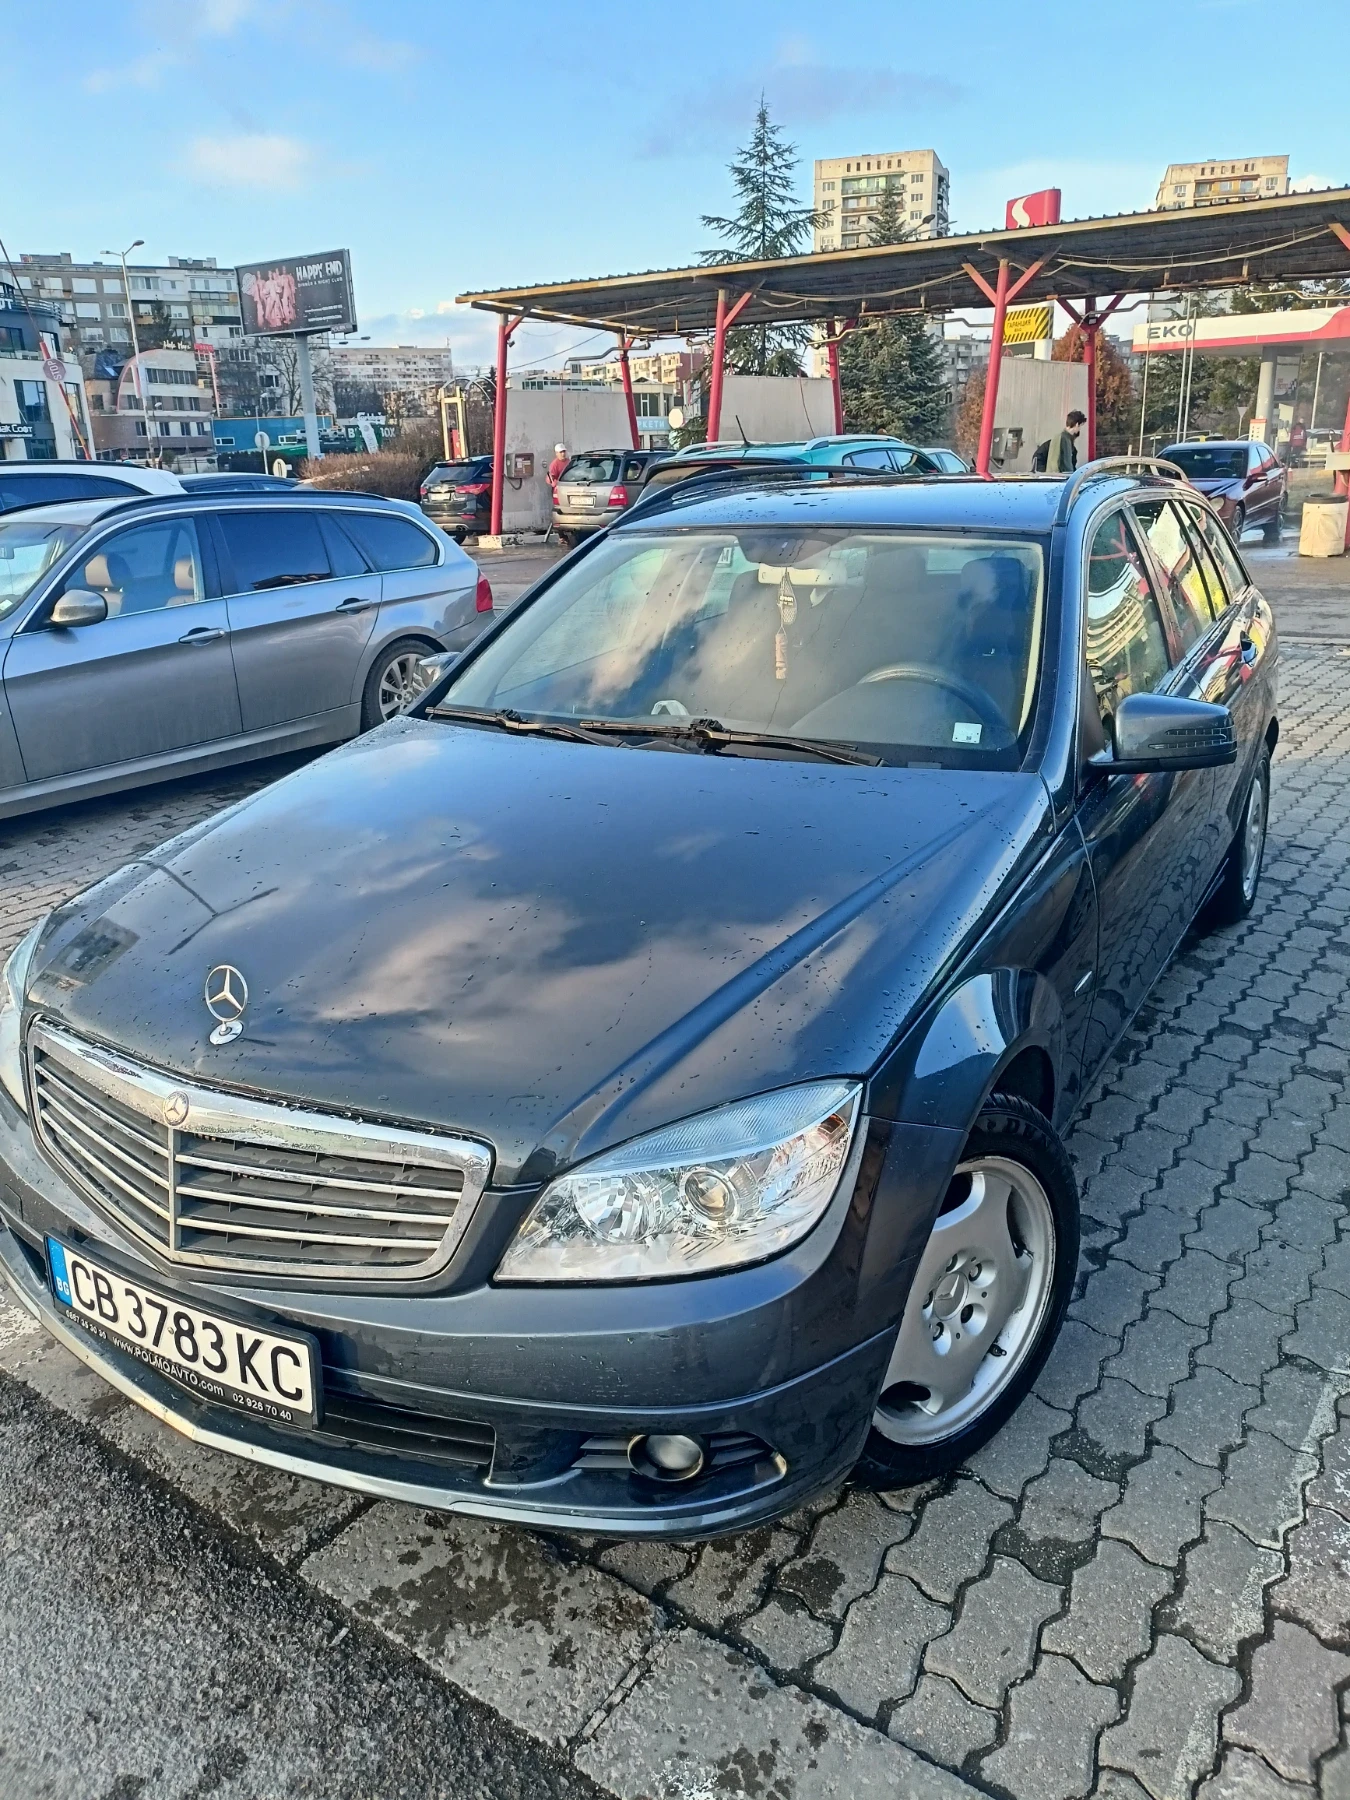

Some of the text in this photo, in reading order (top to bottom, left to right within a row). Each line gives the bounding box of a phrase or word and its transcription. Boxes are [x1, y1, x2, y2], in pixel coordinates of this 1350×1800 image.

[295, 260, 343, 281] HAPPY END
[1147, 324, 1193, 339] EKO
[47, 359, 63, 381] STOP
[55, 1275, 70, 1296] BG
[71, 1260, 304, 1402] CB 3783 KC
[112, 1336, 225, 1397] www.POLMOAVTO.com
[232, 1393, 245, 1405] 02
[246, 1397, 265, 1412] 926
[265, 1404, 278, 1417] 70
[280, 1411, 293, 1421] 40
